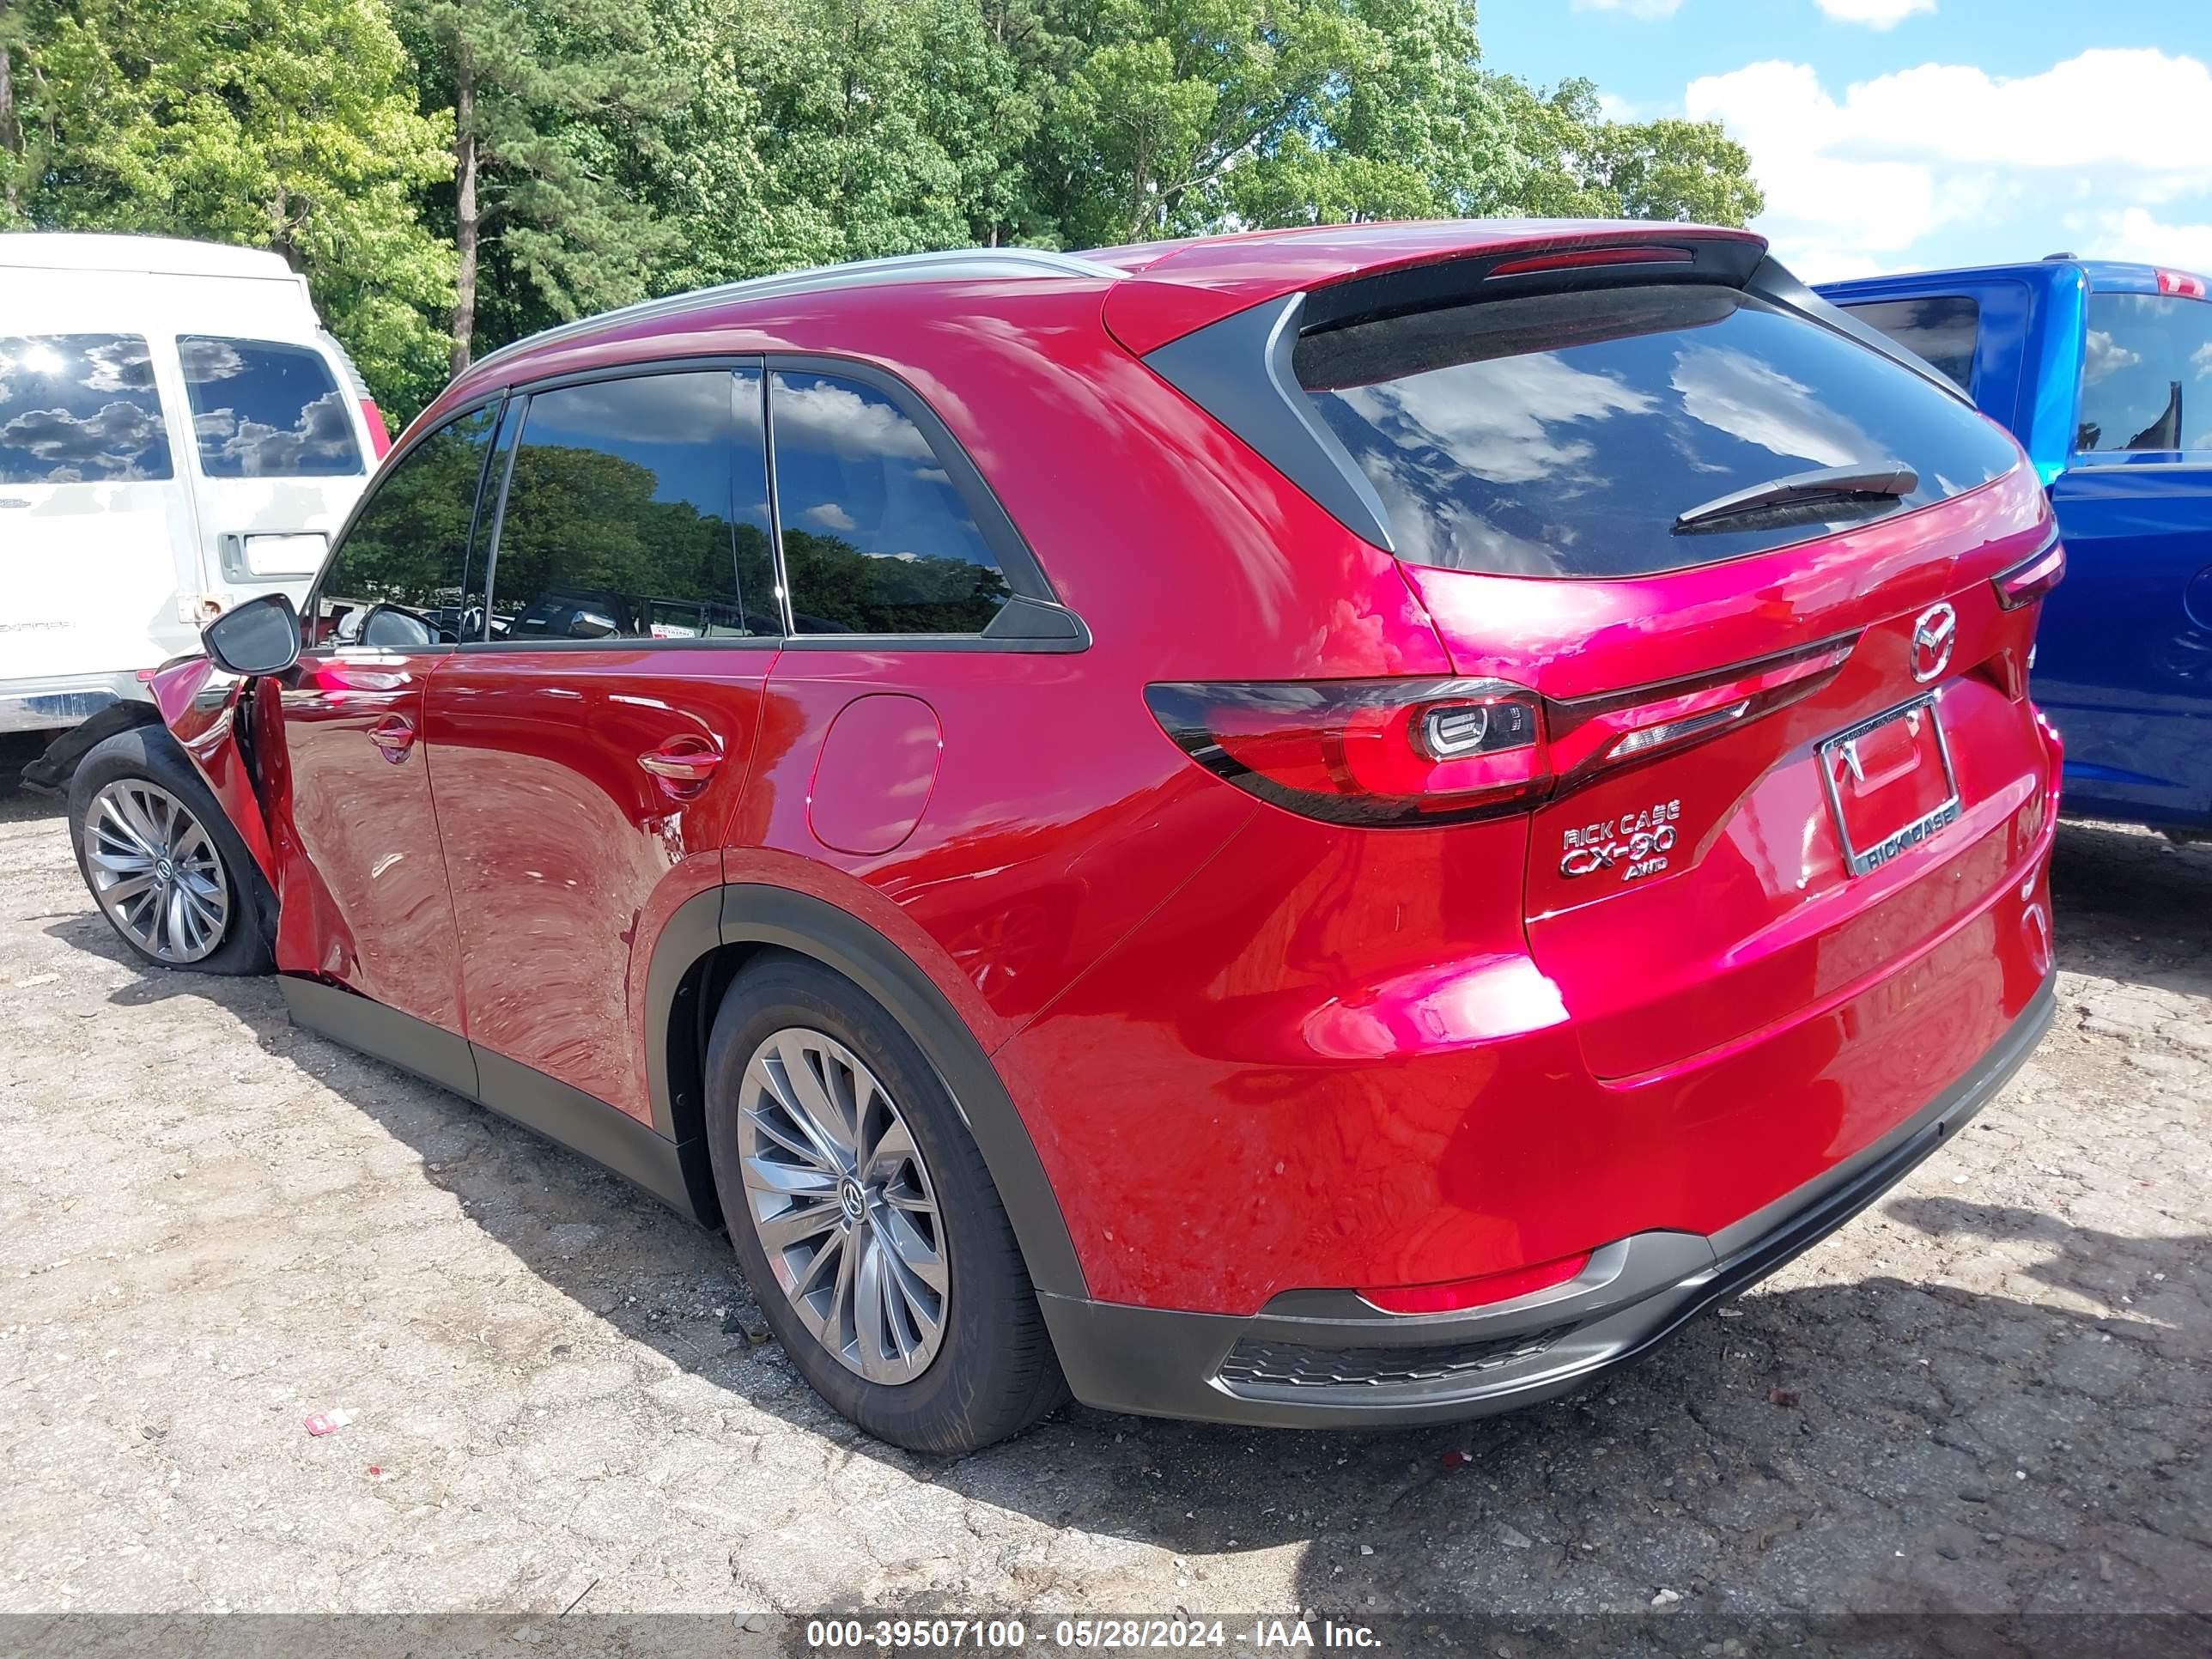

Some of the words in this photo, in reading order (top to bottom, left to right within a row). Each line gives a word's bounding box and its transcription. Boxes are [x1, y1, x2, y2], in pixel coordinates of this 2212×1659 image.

[1560, 824, 1676, 876] CX-90
[1563, 819, 1614, 850] RICK
[1620, 799, 1681, 836] CASE
[1867, 836, 1907, 870] RICK
[1911, 809, 1954, 842] CASE
[1621, 856, 1668, 881] AWD
